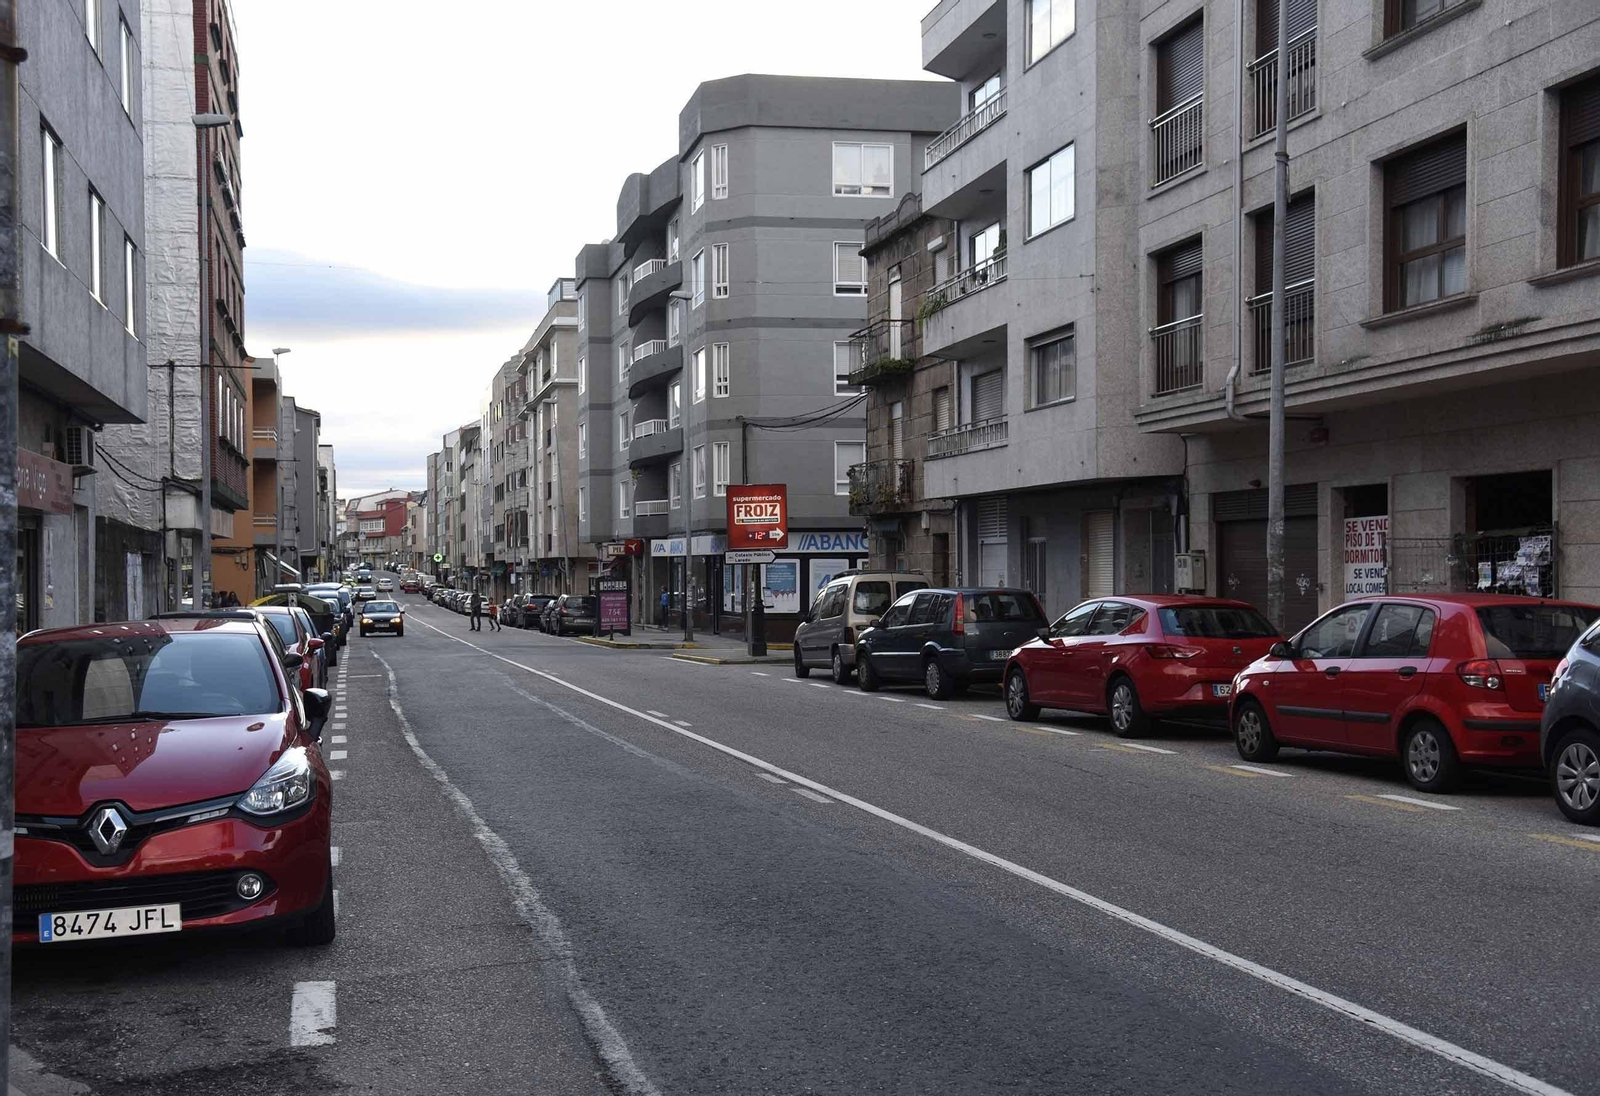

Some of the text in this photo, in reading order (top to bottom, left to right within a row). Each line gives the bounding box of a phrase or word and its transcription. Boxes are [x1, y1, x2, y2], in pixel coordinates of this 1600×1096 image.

[733, 494, 782, 503] supermercado
[736, 504, 778, 518] FROIZ
[1346, 522, 1358, 532] SE
[1346, 533, 1363, 547] PISO
[1365, 533, 1375, 546] DE
[1353, 568, 1363, 579] SE
[1345, 583, 1365, 594] LOCAL
[53, 907, 174, 937] 8474 JFL
